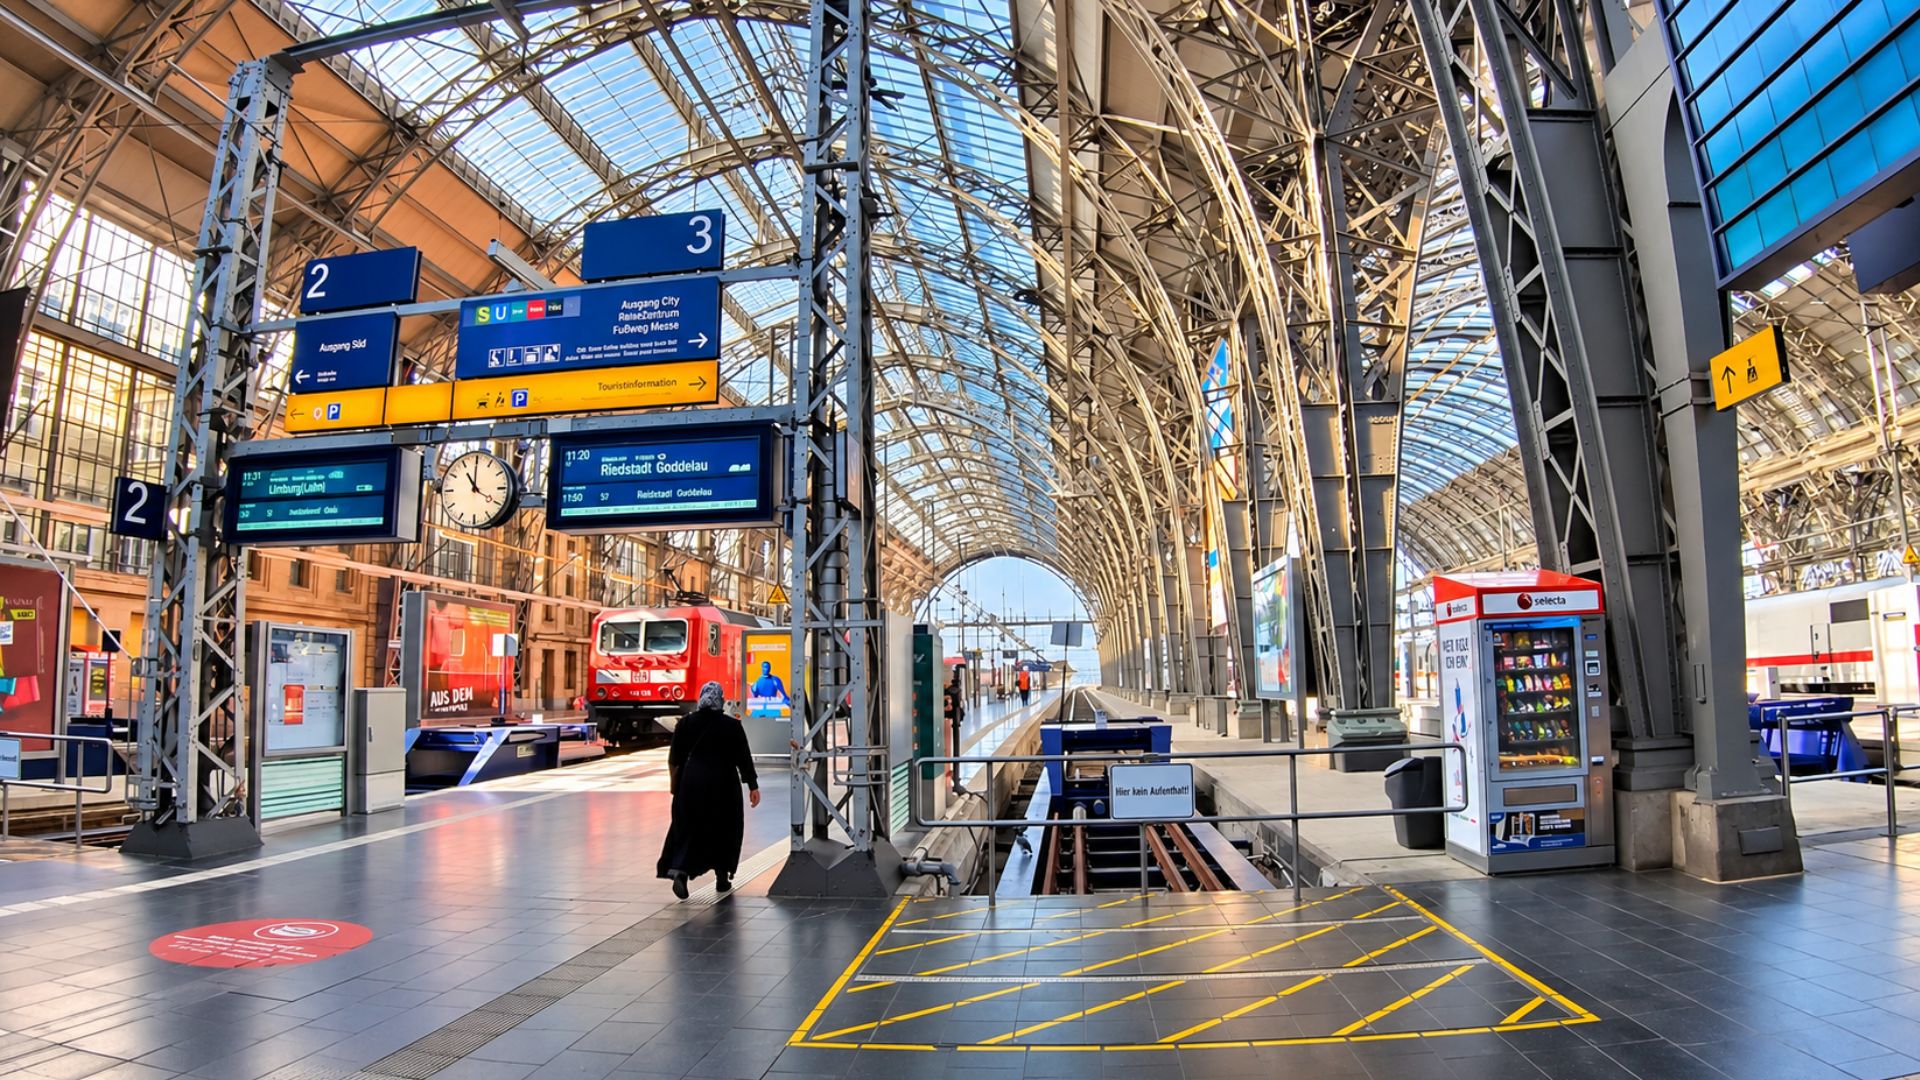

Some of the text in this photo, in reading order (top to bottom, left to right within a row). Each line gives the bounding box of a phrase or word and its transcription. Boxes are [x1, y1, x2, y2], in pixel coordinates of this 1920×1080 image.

[686, 215, 712, 254] 3
[306, 263, 330, 299] 2
[621, 297, 680, 310] Ausgang City
[478, 306, 491, 323] S
[495, 305, 507, 320] U
[613, 321, 680, 335] Fußweg Messe
[319, 339, 367, 353] Ausgang Süd
[598, 378, 677, 391] Touristinformation
[515, 391, 525, 405] P
[328, 404, 339, 417] P
[601, 460, 708, 477] Riedstadt Goddelau
[124, 481, 149, 524] 2
[1534, 595, 1567, 606] selecta
[430, 689, 450, 708] AUS
[452, 686, 473, 704] DEM
[1115, 784, 1190, 796] Hier kein Aufenthalt!
